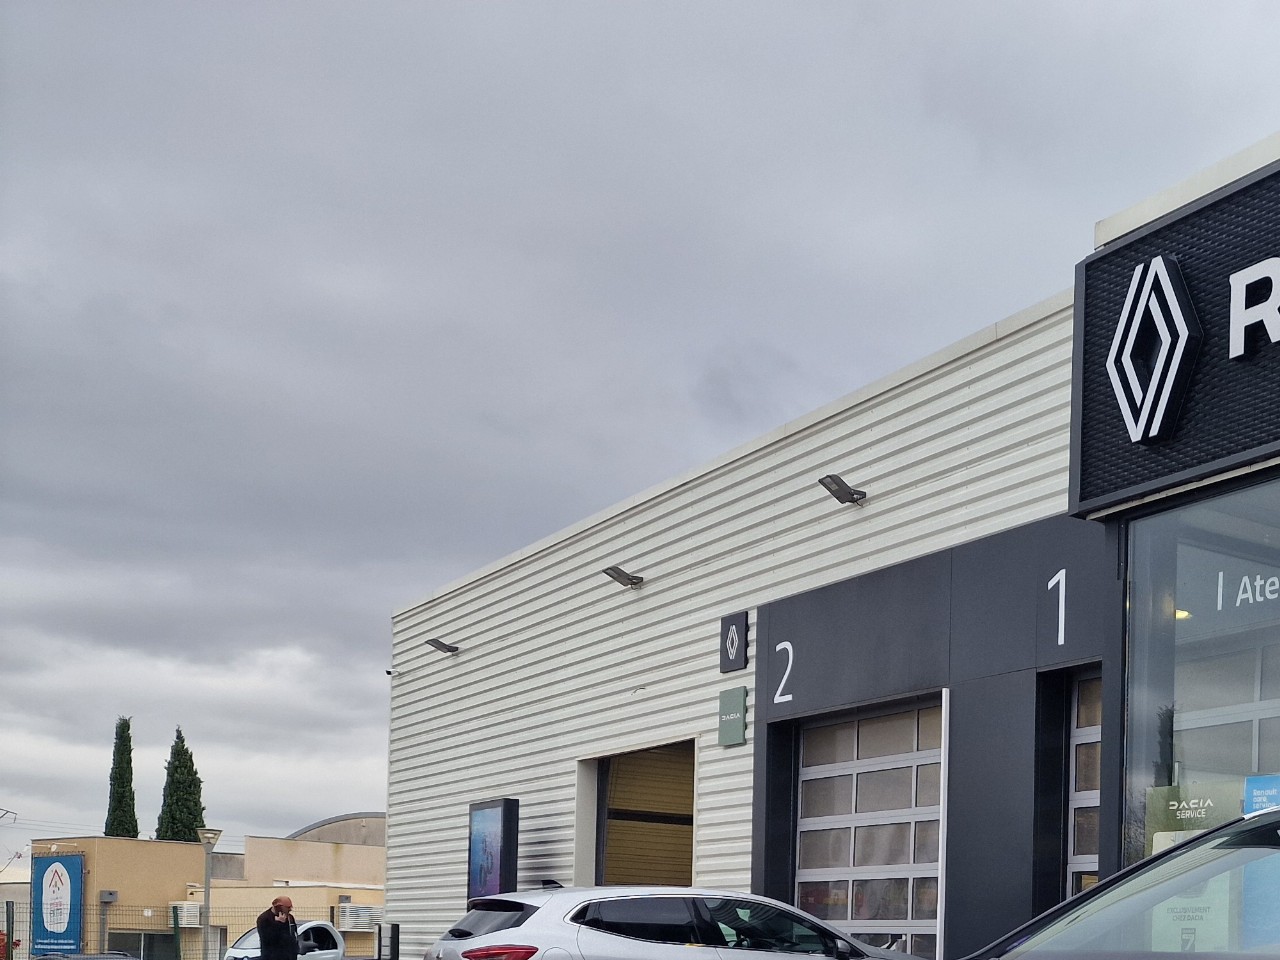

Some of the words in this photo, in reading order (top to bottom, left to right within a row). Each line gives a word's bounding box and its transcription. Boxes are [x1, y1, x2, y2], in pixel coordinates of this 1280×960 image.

[1047, 568, 1066, 646] 1
[773, 641, 794, 704] 2
[1252, 787, 1278, 797] Renault
[1169, 798, 1214, 810] DACIA
[1176, 807, 1206, 819] SERVICE
